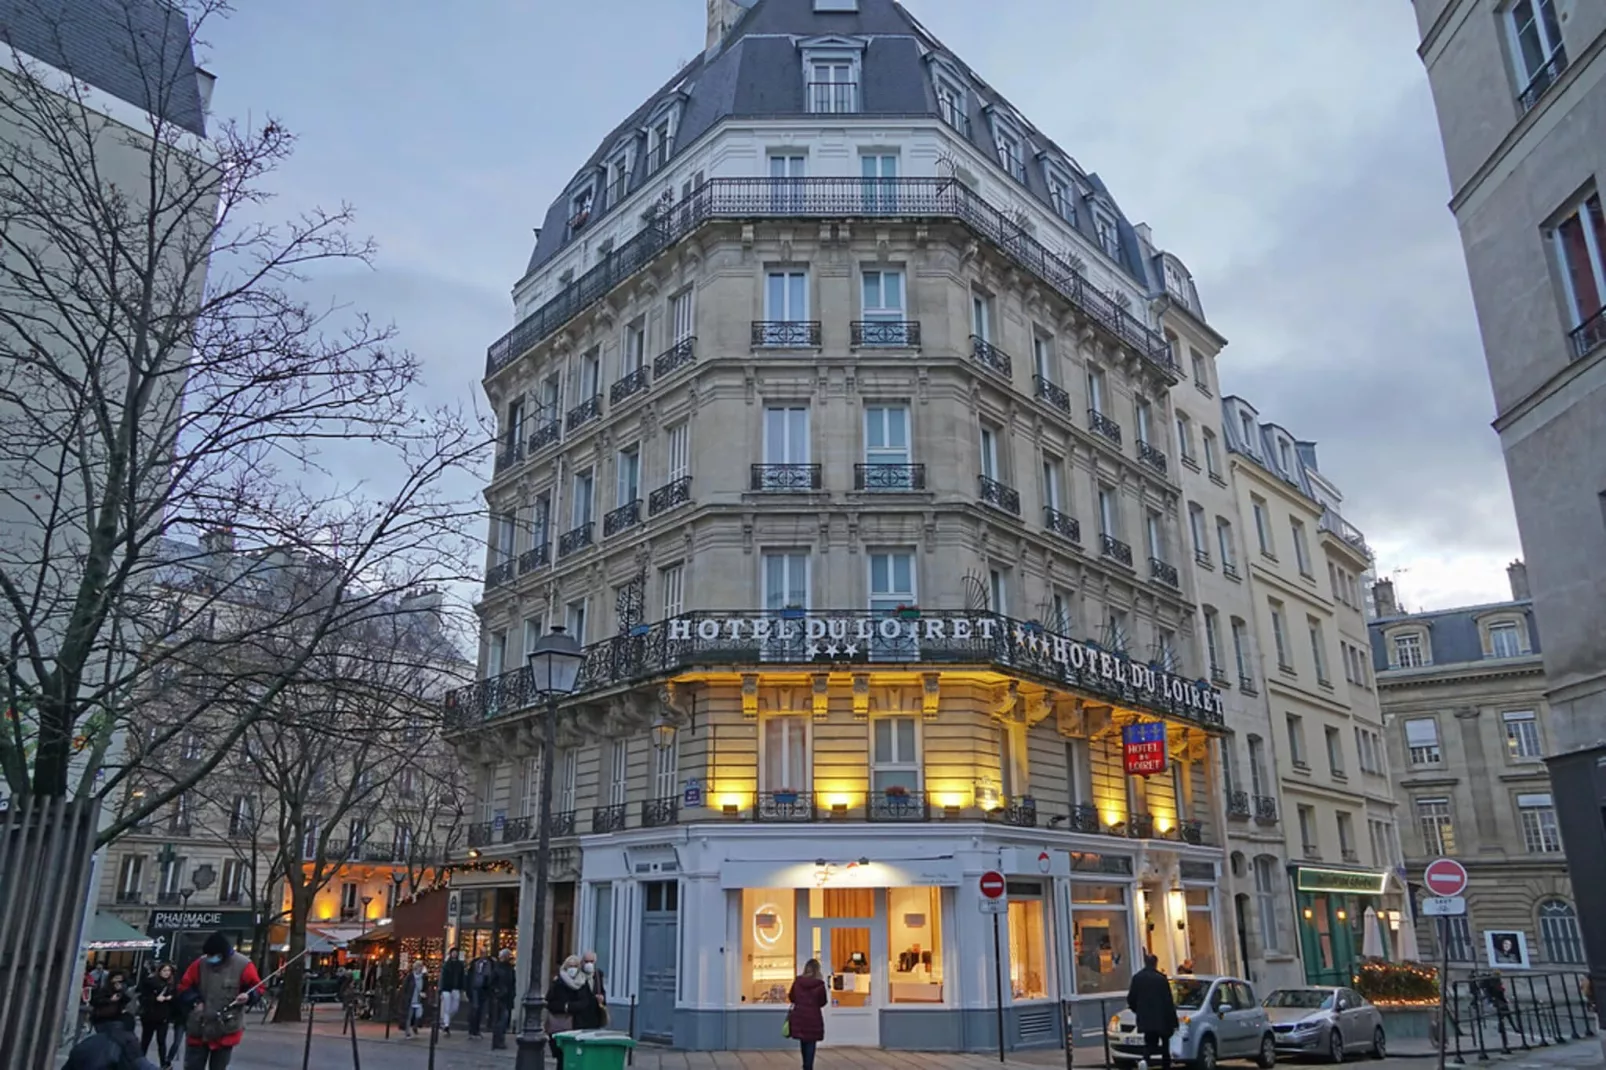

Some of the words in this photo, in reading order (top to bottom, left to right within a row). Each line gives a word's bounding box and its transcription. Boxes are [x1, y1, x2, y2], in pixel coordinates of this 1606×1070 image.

[669, 619, 795, 640] HOTEL
[806, 619, 847, 639] DU
[856, 619, 997, 639] LOIRET
[1053, 635, 1126, 684] HOTEL
[1131, 663, 1156, 693] DU
[1162, 674, 1224, 715] LOIRET
[1128, 743, 1158, 754] HOTEL
[1128, 760, 1161, 771] LOIRET
[155, 912, 222, 924] PHARMACIE
